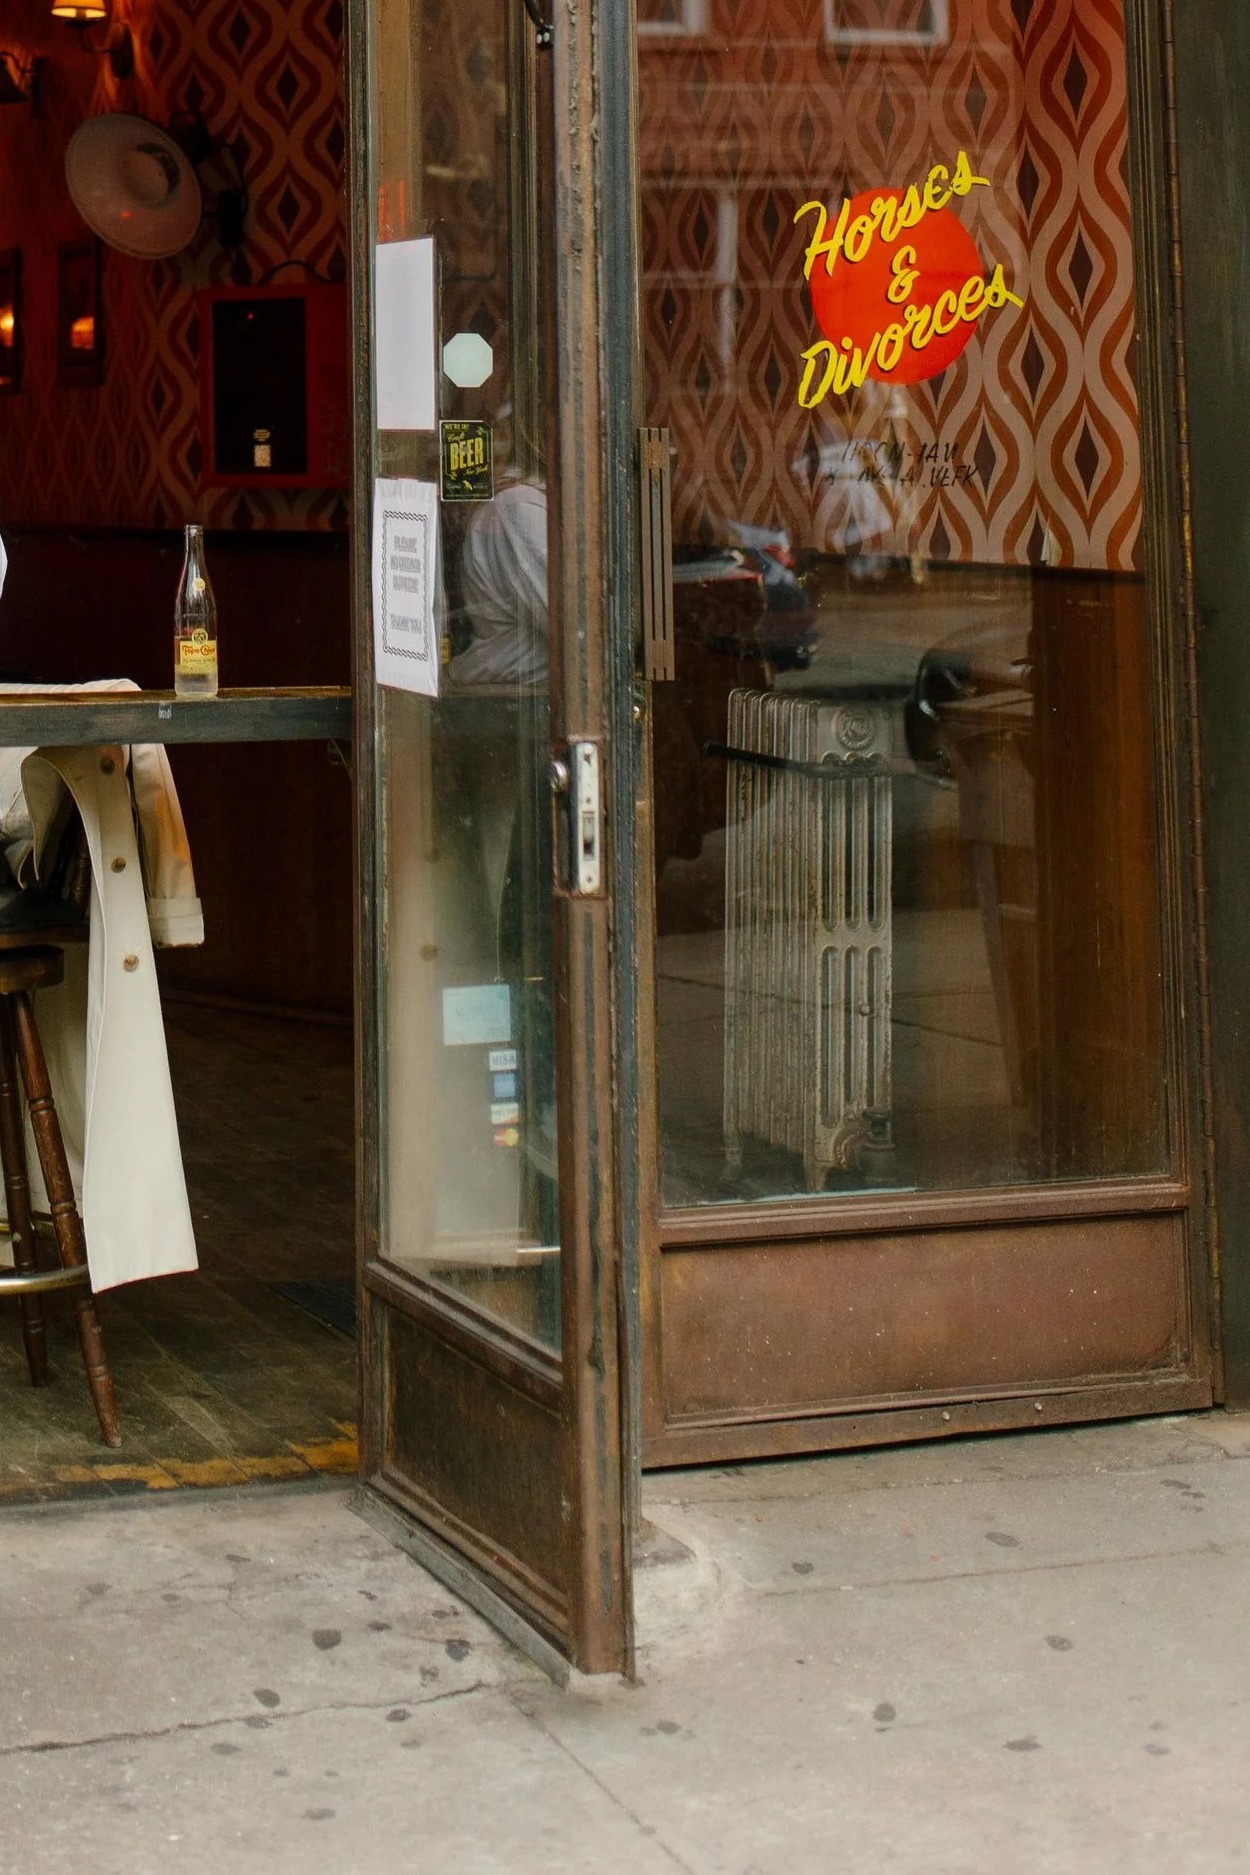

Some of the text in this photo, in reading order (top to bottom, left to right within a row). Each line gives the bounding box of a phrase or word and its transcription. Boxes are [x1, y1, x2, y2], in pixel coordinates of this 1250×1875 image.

[793, 150, 991, 281] Horses
[887, 245, 921, 304] &
[797, 263, 1024, 409] Divorces
[450, 437, 484, 471] BEER
[492, 1054, 516, 1065] VISA
